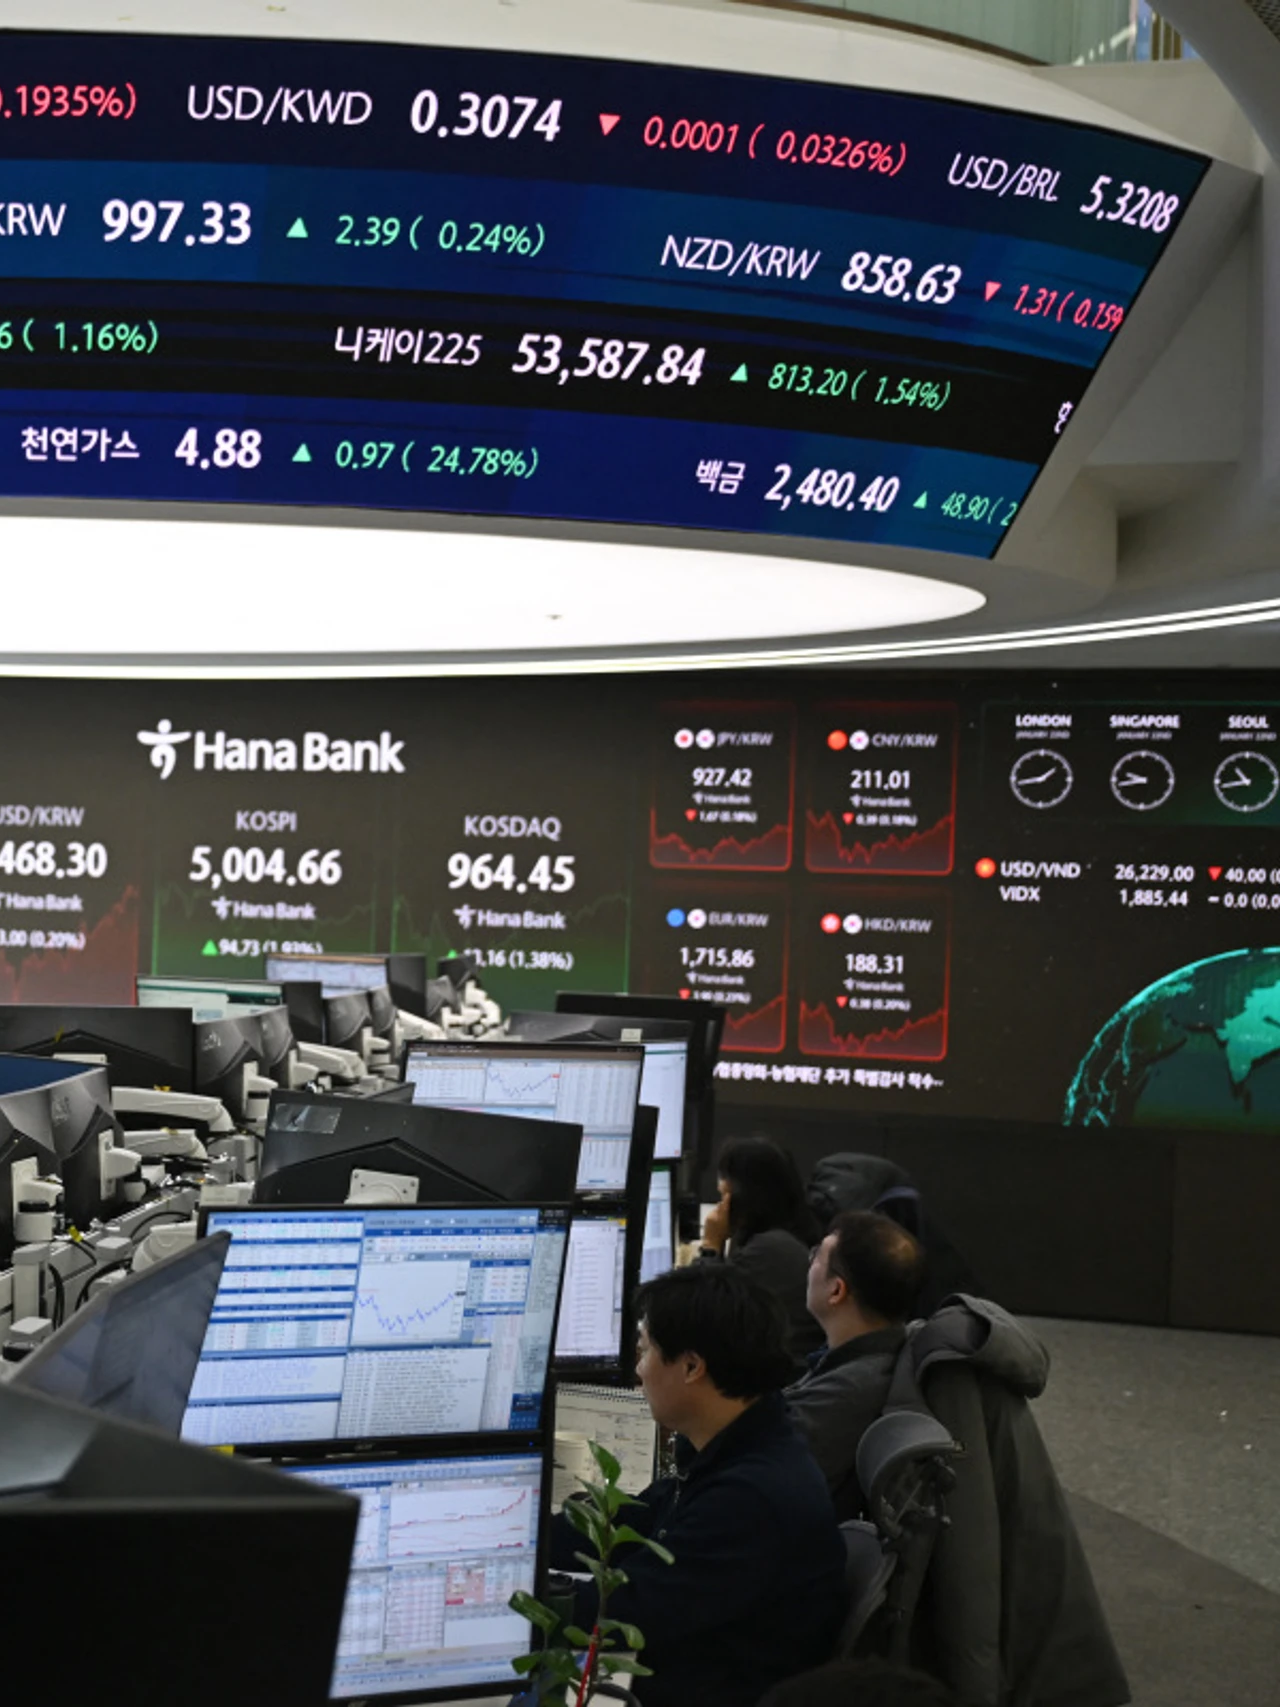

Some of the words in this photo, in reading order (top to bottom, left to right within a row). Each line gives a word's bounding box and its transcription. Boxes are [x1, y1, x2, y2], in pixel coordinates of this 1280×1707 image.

[188, 85, 372, 124] USD/KWD
[411, 90, 562, 141] 0.3074
[948, 153, 1060, 201] USD/BRL
[1080, 175, 1178, 233] 5.3208
[103, 199, 250, 246] 997.33
[661, 235, 820, 280] NZD/KRW
[841, 252, 961, 304] 858.63
[335, 327, 482, 365] 니케이225
[512, 334, 705, 385] 53,587.84
[22, 427, 140, 461] 천연가스
[175, 427, 261, 469] 4.88
[696, 460, 745, 494] 백금
[765, 464, 900, 512] 2,480.40
[1016, 715, 1071, 726] LONDON
[1110, 715, 1179, 728] SINGAPORE
[1229, 716, 1268, 728] SEOUL
[717, 732, 772, 746] JPY/KRW
[872, 734, 937, 746] CNY/KRW
[693, 768, 752, 786] 927.42
[851, 770, 909, 789] 211.01
[236, 811, 296, 831] KOSPI
[465, 816, 561, 841] KOSDAQ
[190, 846, 341, 889] 5,004.66
[448, 853, 574, 893] 964.45
[1001, 861, 1080, 878] USD/VND
[1115, 864, 1194, 882] 26,229.00
[1225, 868, 1266, 882] 40.00
[1000, 886, 1040, 901] VIDX
[1121, 889, 1188, 906] 1,885.44
[709, 912, 768, 926] EUR/KRW
[865, 918, 931, 932] HKD/KRW
[30, 931, 86, 950] (0.20%)
[509, 951, 573, 970] (1.38%)
[681, 947, 754, 967] 1,715.86
[846, 954, 903, 973] 188.31
